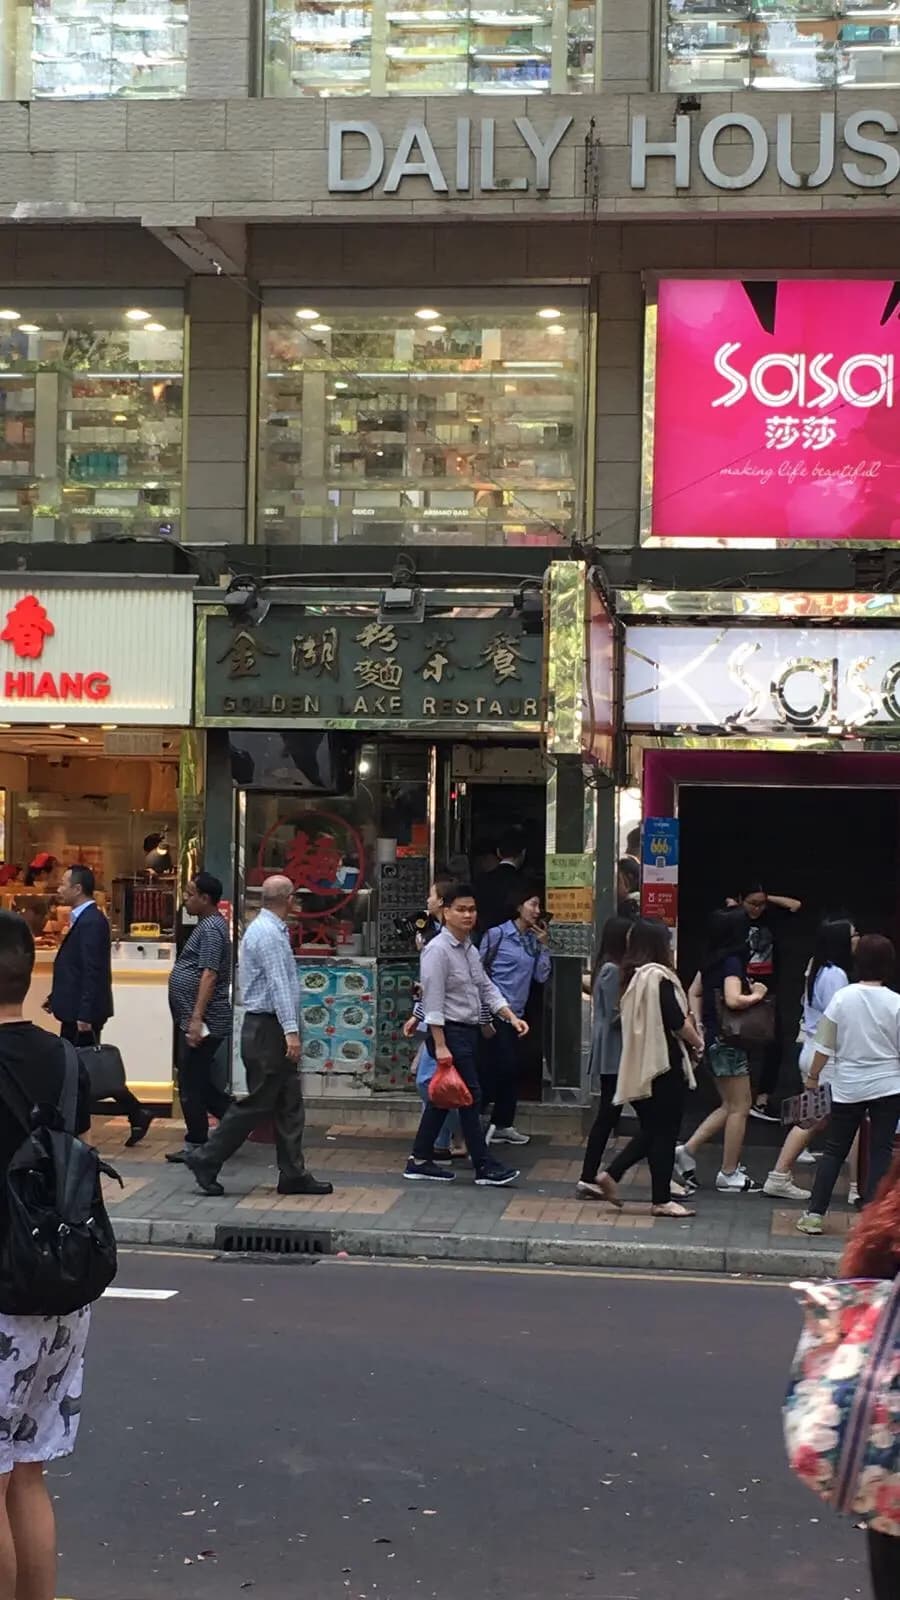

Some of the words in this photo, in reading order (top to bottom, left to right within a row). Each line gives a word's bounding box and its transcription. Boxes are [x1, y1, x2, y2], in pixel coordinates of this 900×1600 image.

[328, 116, 575, 193] DAILY
[631, 109, 900, 190] HOUS
[711, 342, 894, 408] Sasa
[765, 415, 837, 451] 莎莎
[719, 458, 773, 484] making
[778, 460, 807, 484] life
[811, 459, 882, 483] beautiful
[1, 594, 55, 659] 香
[4, 671, 112, 701] HIANG
[223, 694, 321, 715] GOLDEN
[337, 695, 403, 715] LAKE
[422, 697, 538, 717] RESTAUR
[720, 641, 900, 727] Sas
